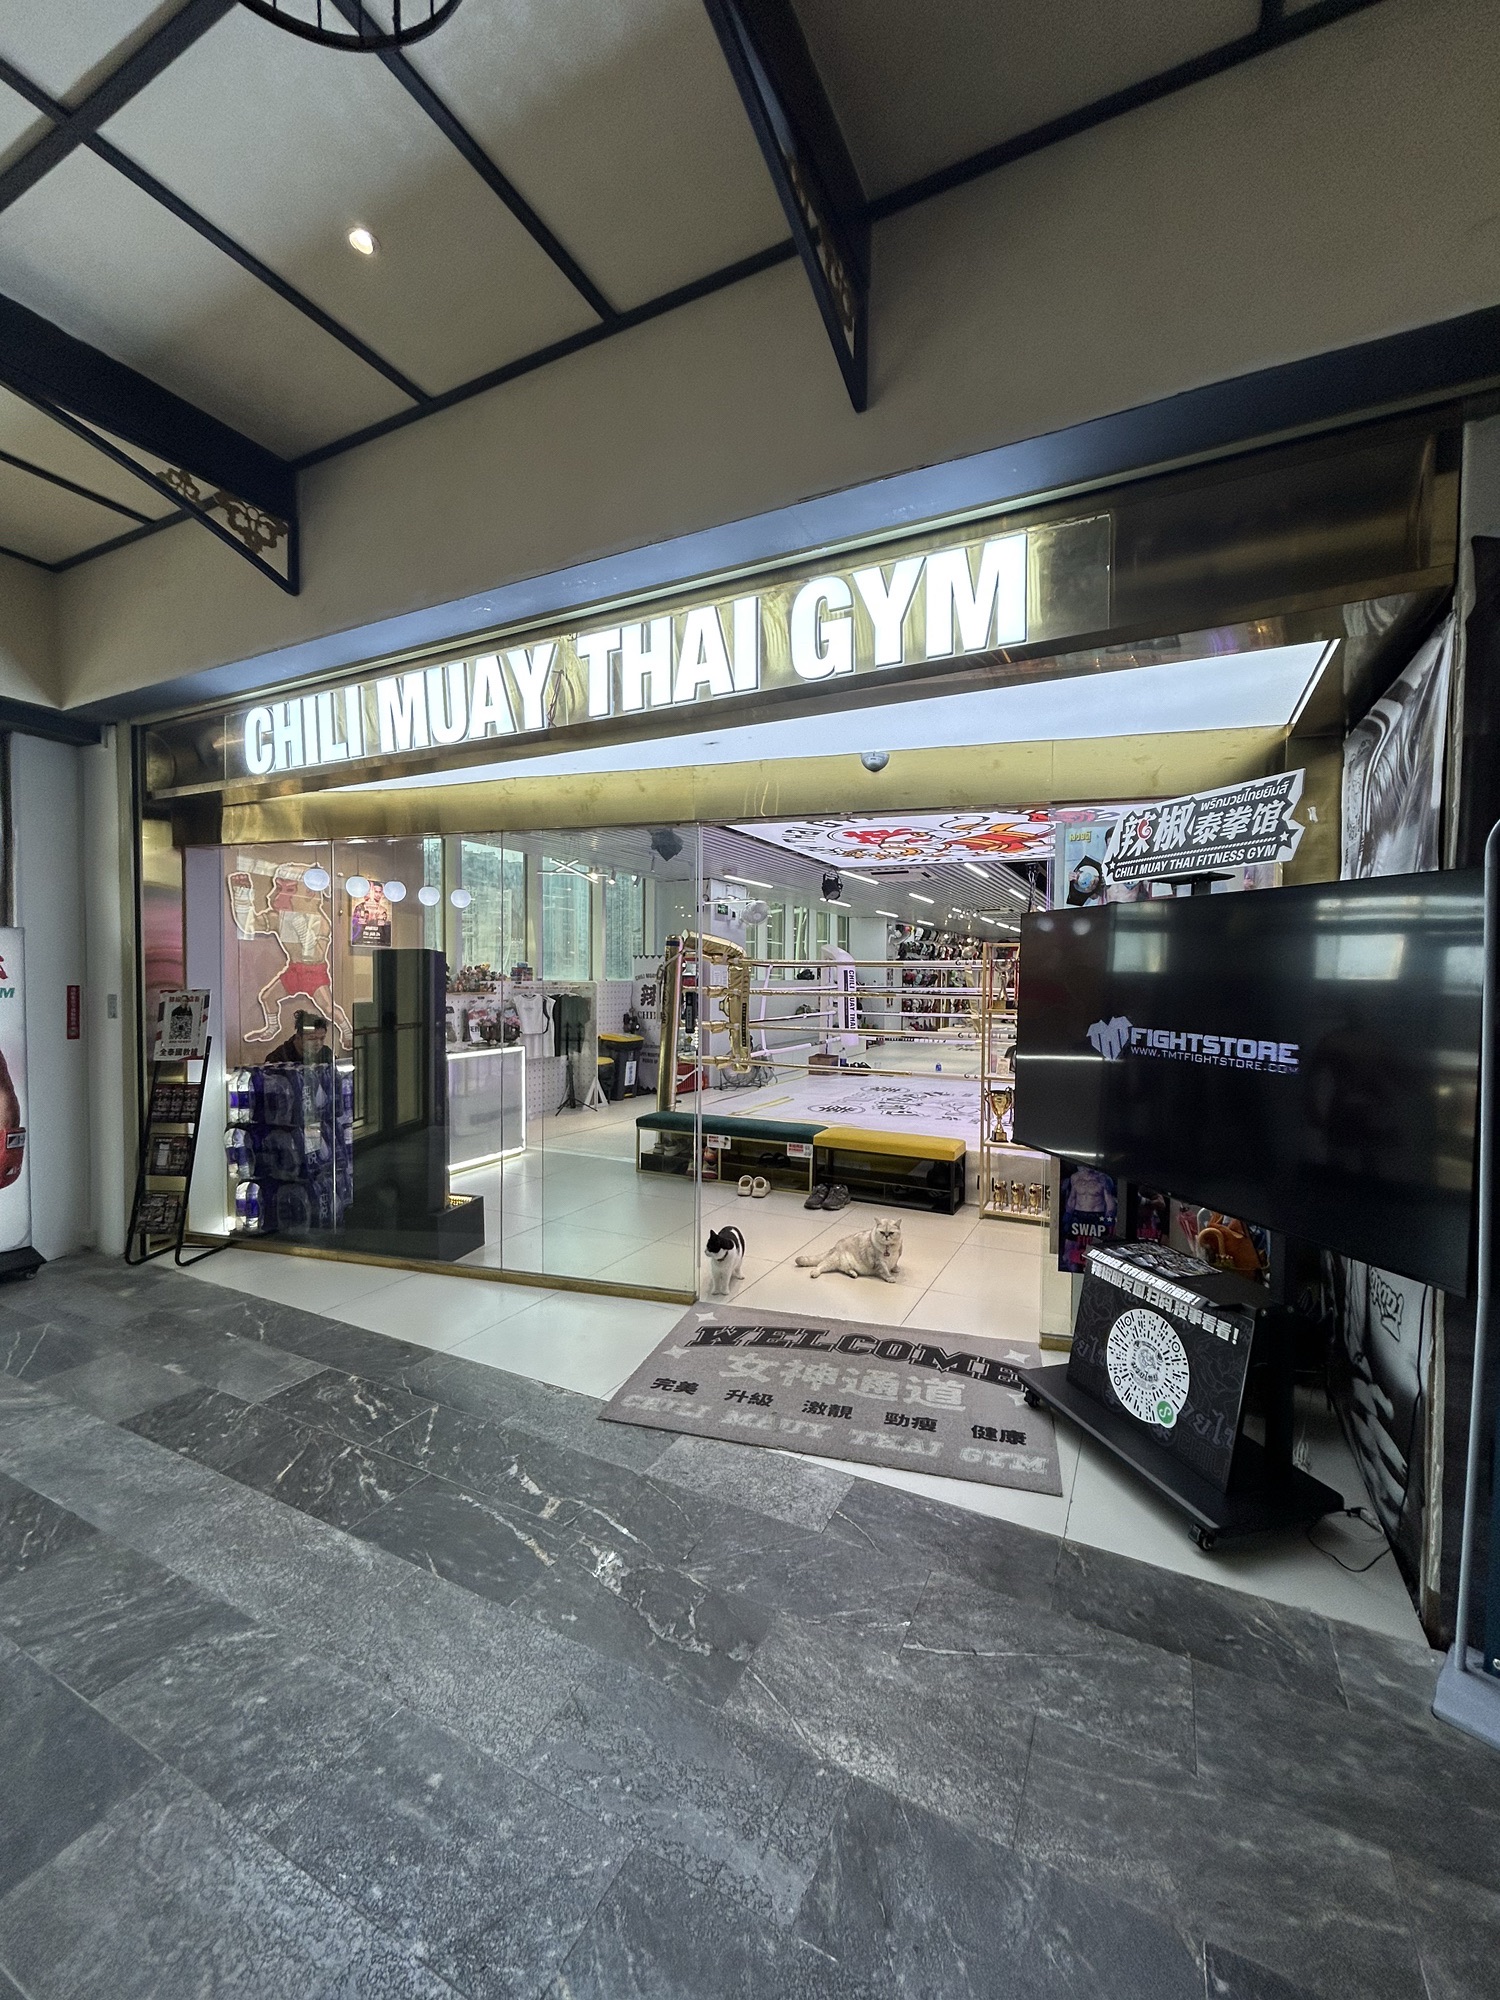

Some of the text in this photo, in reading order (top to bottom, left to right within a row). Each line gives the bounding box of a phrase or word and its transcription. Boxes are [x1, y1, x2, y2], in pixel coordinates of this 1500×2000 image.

[243, 533, 1029, 776] CHILI MUAY THAI GYM
[1192, 799, 1286, 845] 泰拳馆
[1114, 843, 1278, 879] CHILI MUAY THAI FITNESS GYM
[1131, 1027, 1300, 1065] FIGHTSTORE
[1071, 1222, 1106, 1237] SWAP
[683, 1325, 1027, 1392] WELCOME
[718, 1352, 967, 1412] 女神通道
[620, 1393, 711, 1419] CHILI
[849, 1427, 945, 1457] THAI
[959, 1446, 1049, 1475] GYM
[649, 1377, 698, 1396] 完美
[724, 1389, 774, 1408] 升級
[884, 1411, 938, 1433] 勁瘦
[971, 1423, 1027, 1446] 健康
